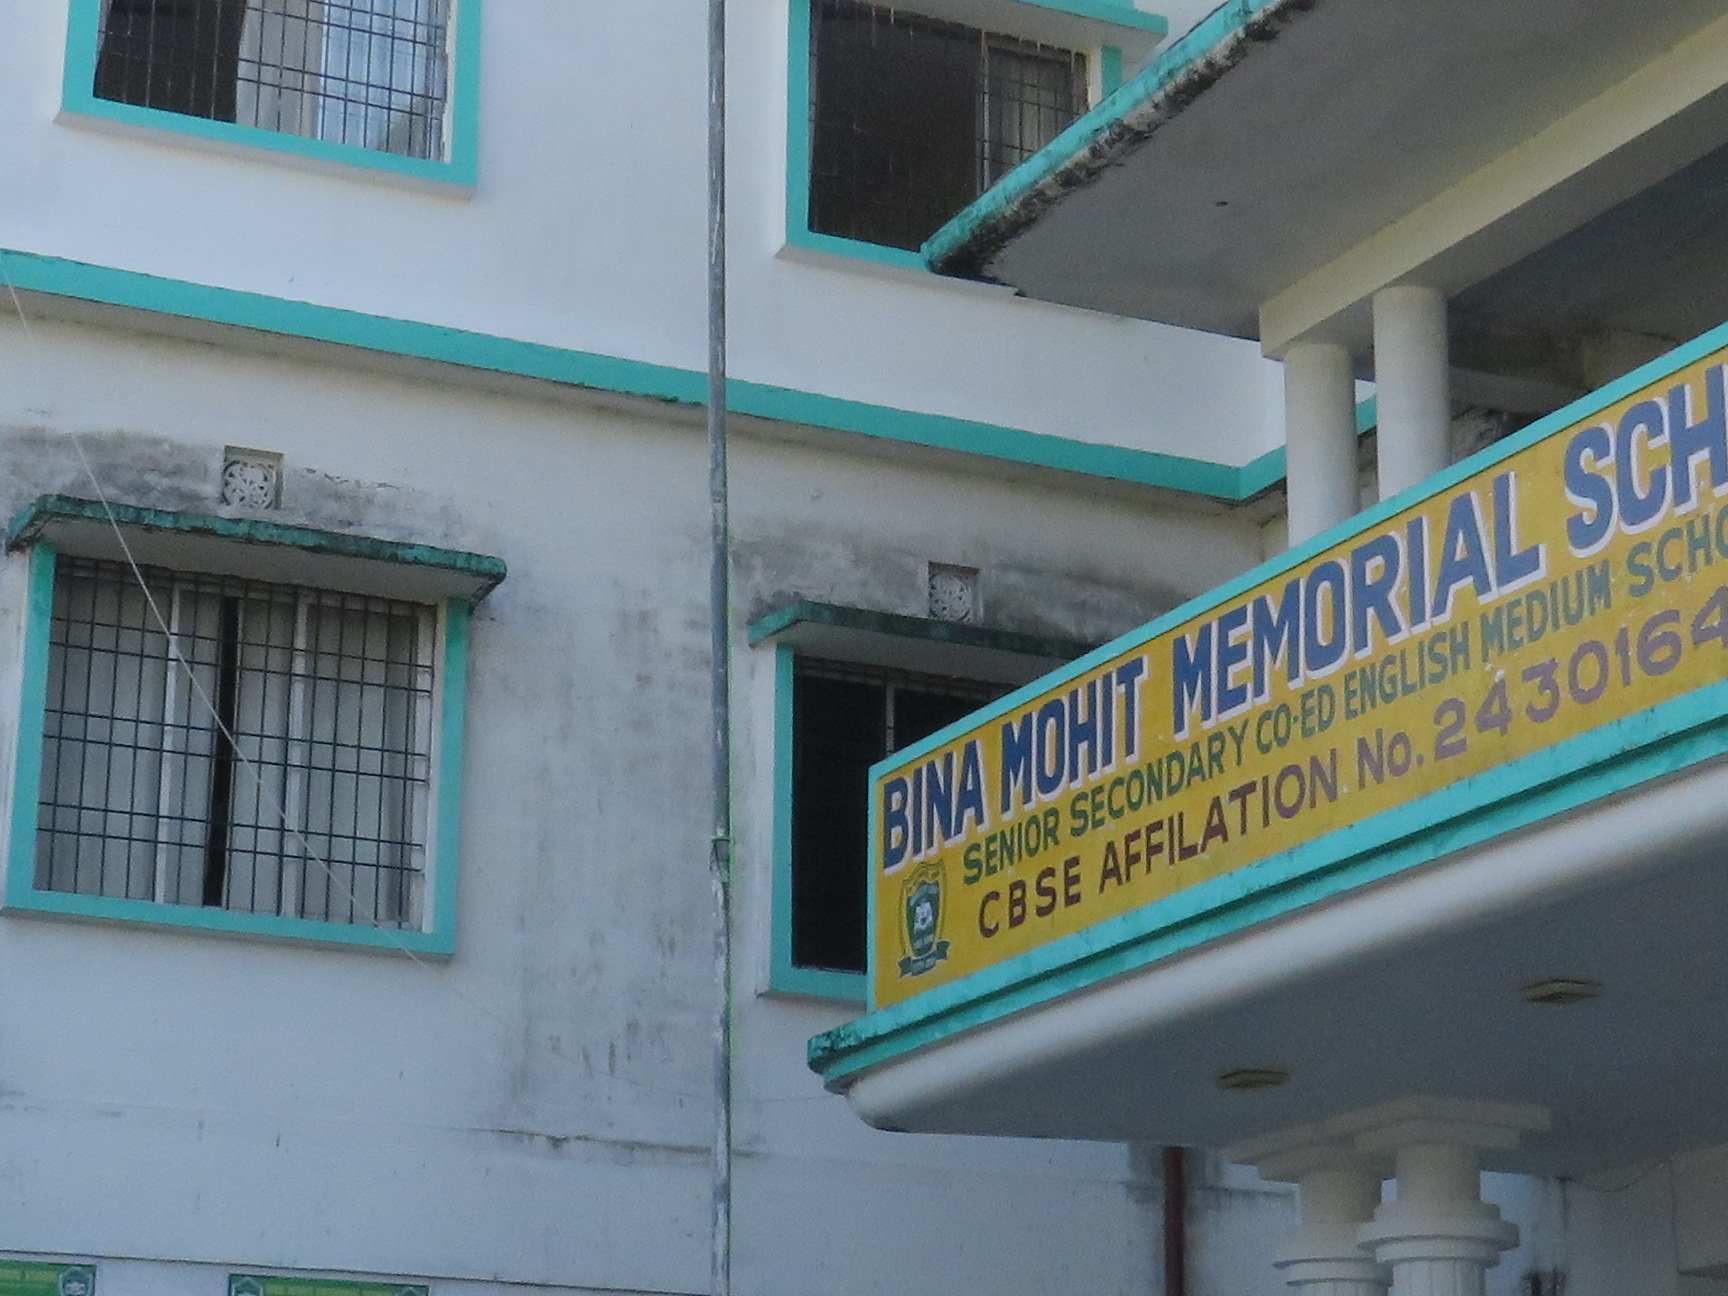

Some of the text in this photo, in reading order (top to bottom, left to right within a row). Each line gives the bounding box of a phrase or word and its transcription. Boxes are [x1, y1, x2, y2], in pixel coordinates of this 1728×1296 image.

[883, 739, 990, 875] BINA
[1001, 655, 1148, 818] MOHIT
[1173, 471, 1547, 741] MEMORIAL
[963, 807, 1060, 885] SENIOR
[1071, 719, 1248, 837] SECONDARY
[1255, 684, 1336, 756] CO-ED
[1344, 621, 1471, 720] ENGLISH
[1480, 560, 1612, 663] MEDIUM
[978, 855, 1081, 937] CBSE
[1099, 748, 1337, 894] AFFILATION
[1357, 729, 1424, 790] No.
